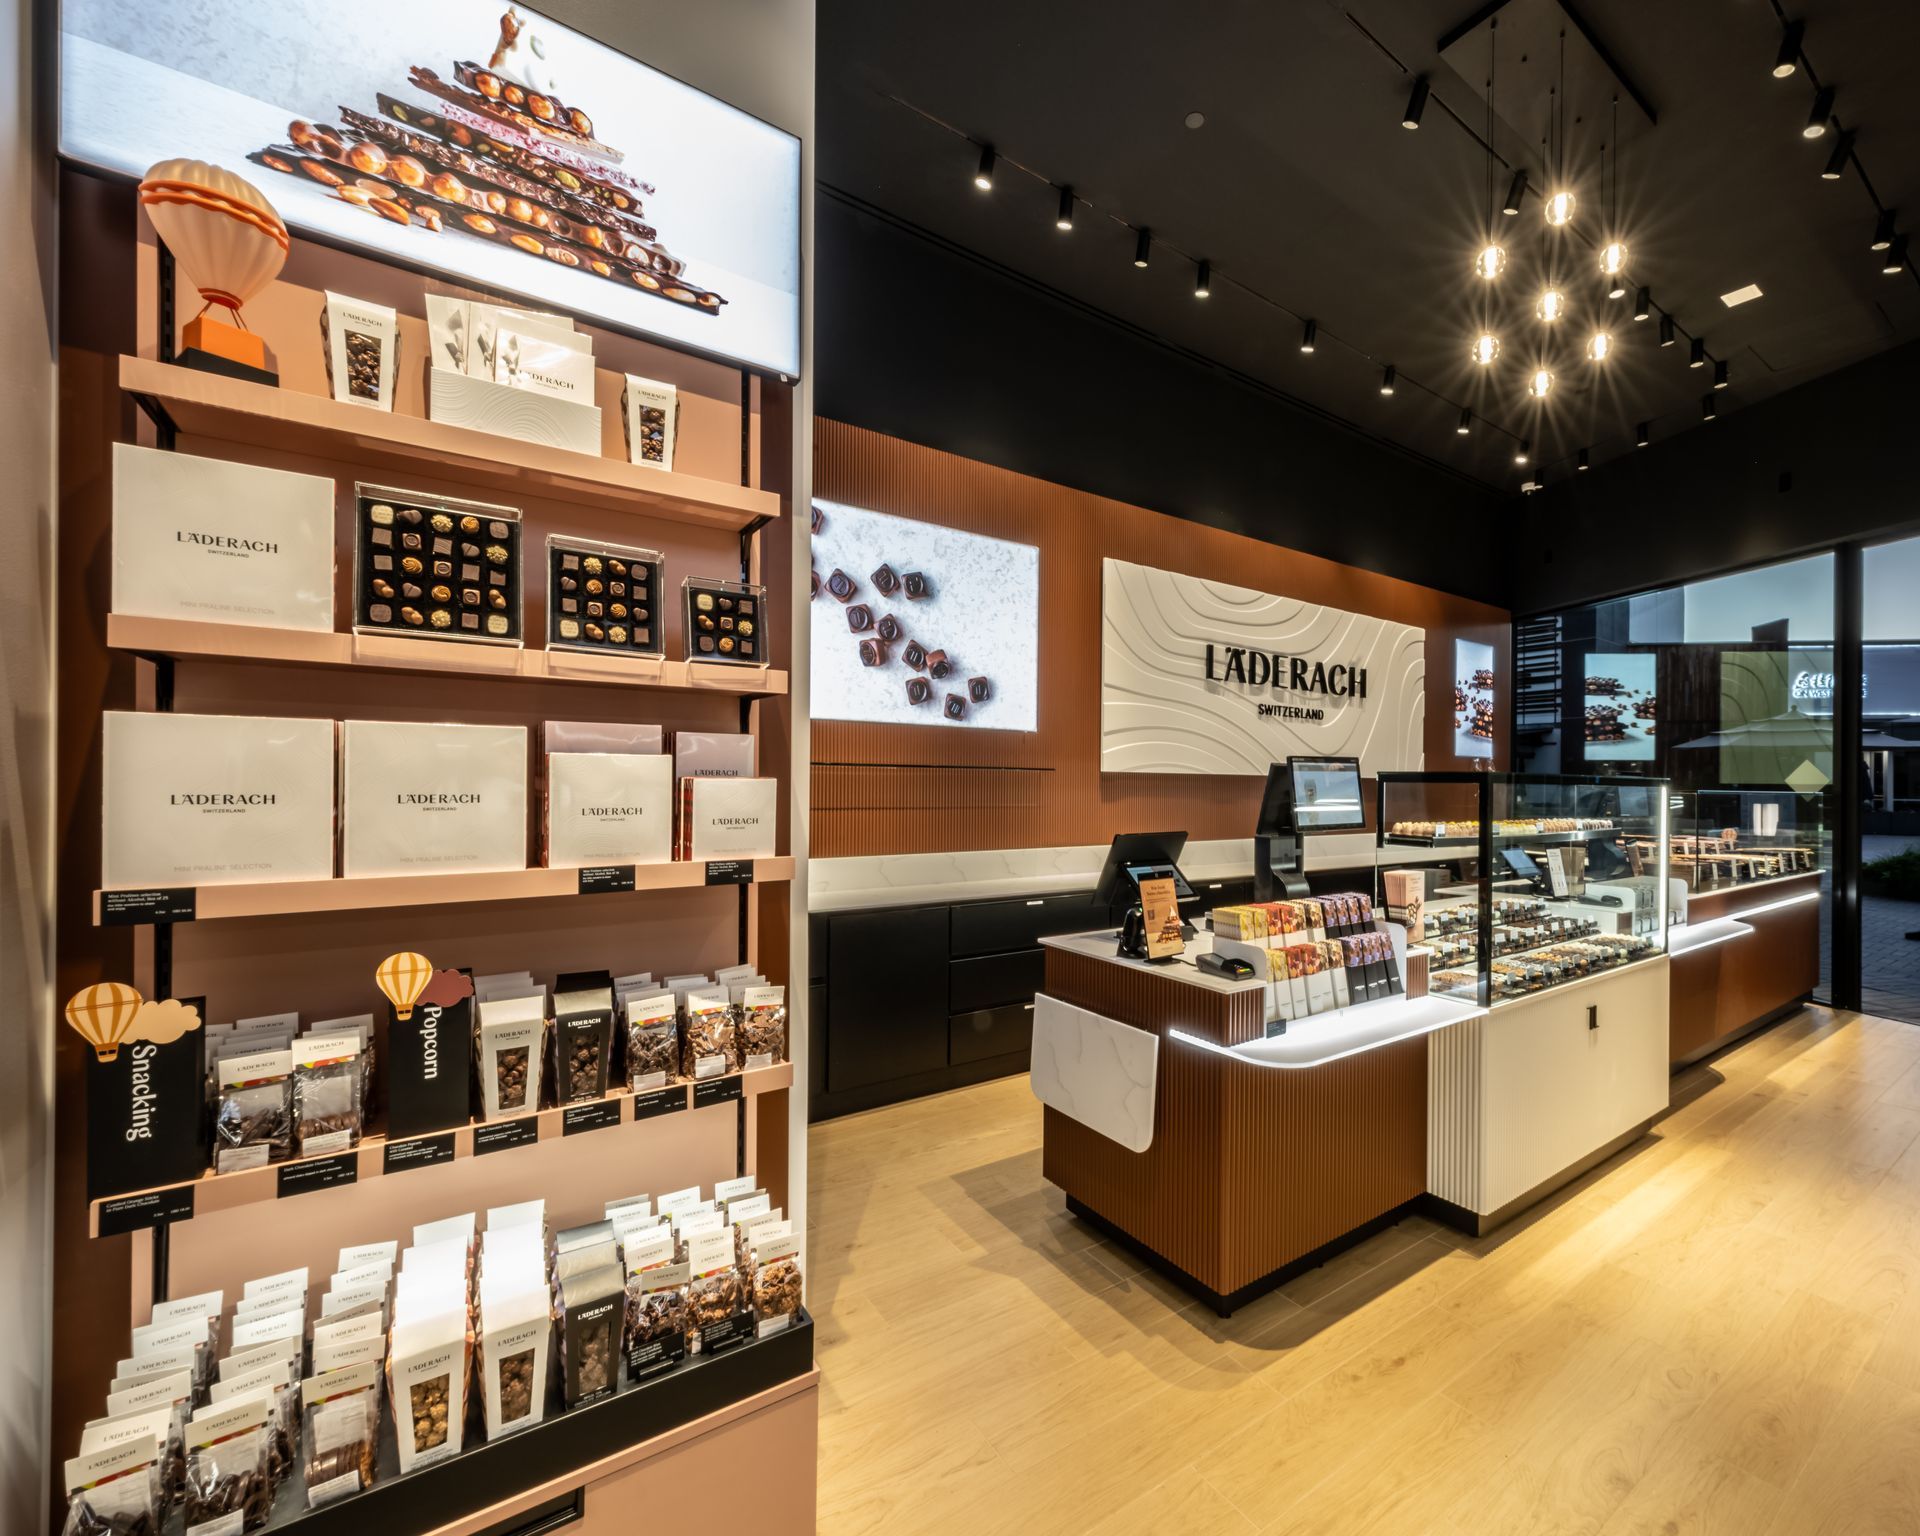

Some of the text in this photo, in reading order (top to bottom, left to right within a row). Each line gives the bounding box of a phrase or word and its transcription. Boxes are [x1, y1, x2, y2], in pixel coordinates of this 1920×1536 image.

[177, 532, 278, 553] LÄDERACH
[208, 549, 250, 558] SWITZERLAND
[1205, 644, 1367, 698] LÄDERACH
[1258, 704, 1324, 720] SWITZERLAND
[171, 794, 275, 805] LÄDERACH
[398, 794, 480, 804] LÄDERACH
[582, 808, 642, 816] LÄDERACH
[420, 1006, 442, 1079] Popcorn
[126, 1045, 157, 1142] Snacking
